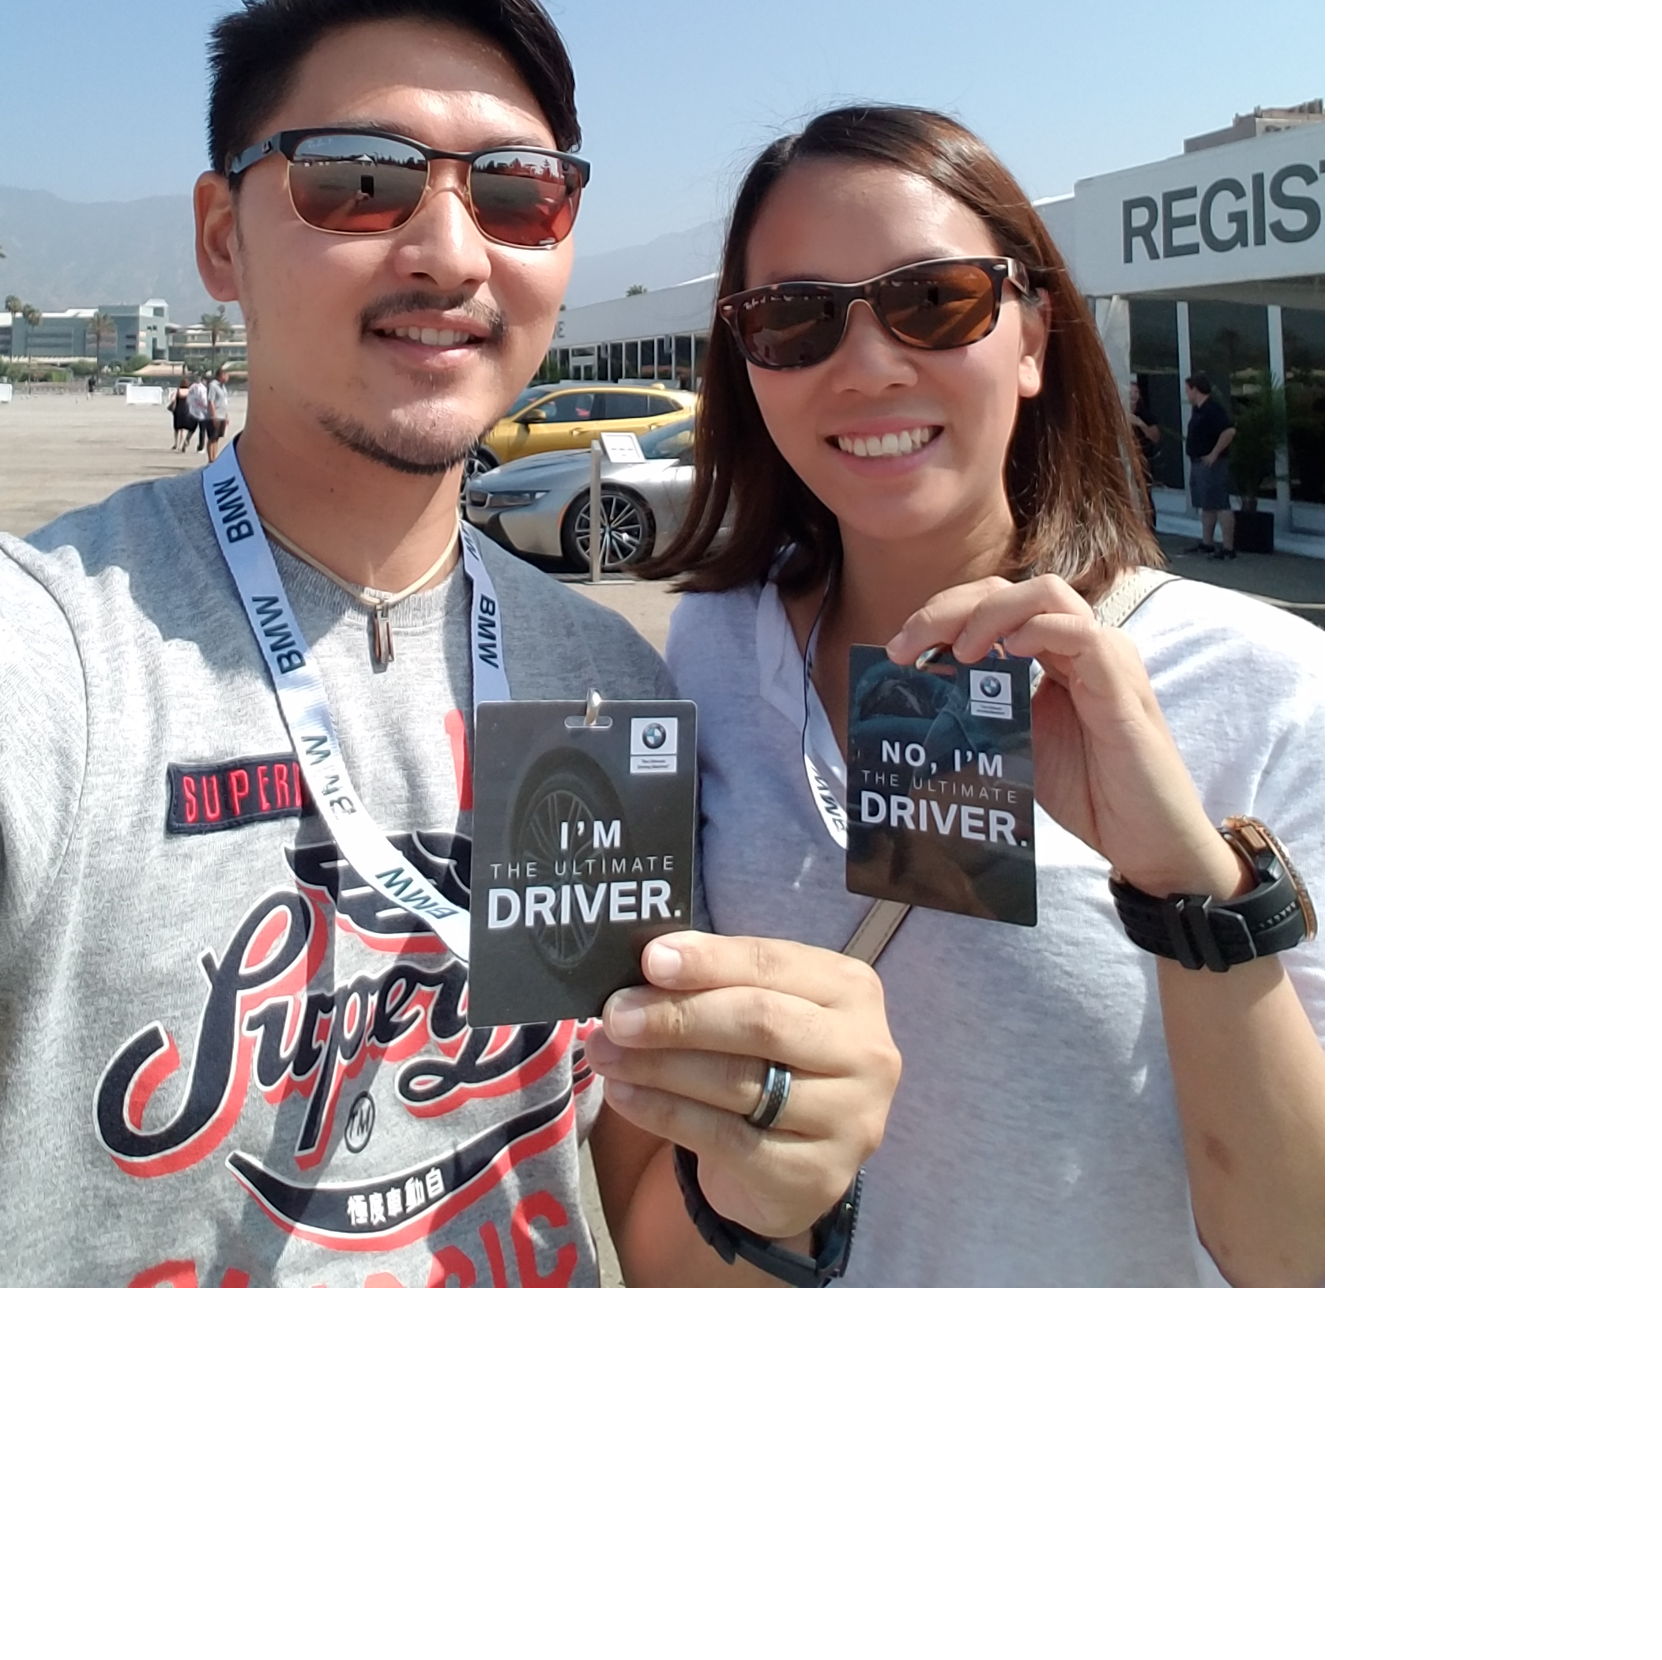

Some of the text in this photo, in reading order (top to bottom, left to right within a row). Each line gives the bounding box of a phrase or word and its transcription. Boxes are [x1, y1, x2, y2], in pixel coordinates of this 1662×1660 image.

[1122, 159, 1325, 264] REGIS
[213, 476, 254, 544] BMW
[251, 596, 306, 674] BMW
[473, 593, 499, 669] BMW
[881, 739, 1003, 778] NO, I'M
[861, 769, 1017, 804] THE ULTIMATE
[560, 819, 622, 850] I'M
[860, 790, 1028, 847] DRIVER.
[375, 866, 460, 919] BMW
[490, 855, 675, 879] THE ULTIMATE
[488, 879, 682, 930] DRIVER.
